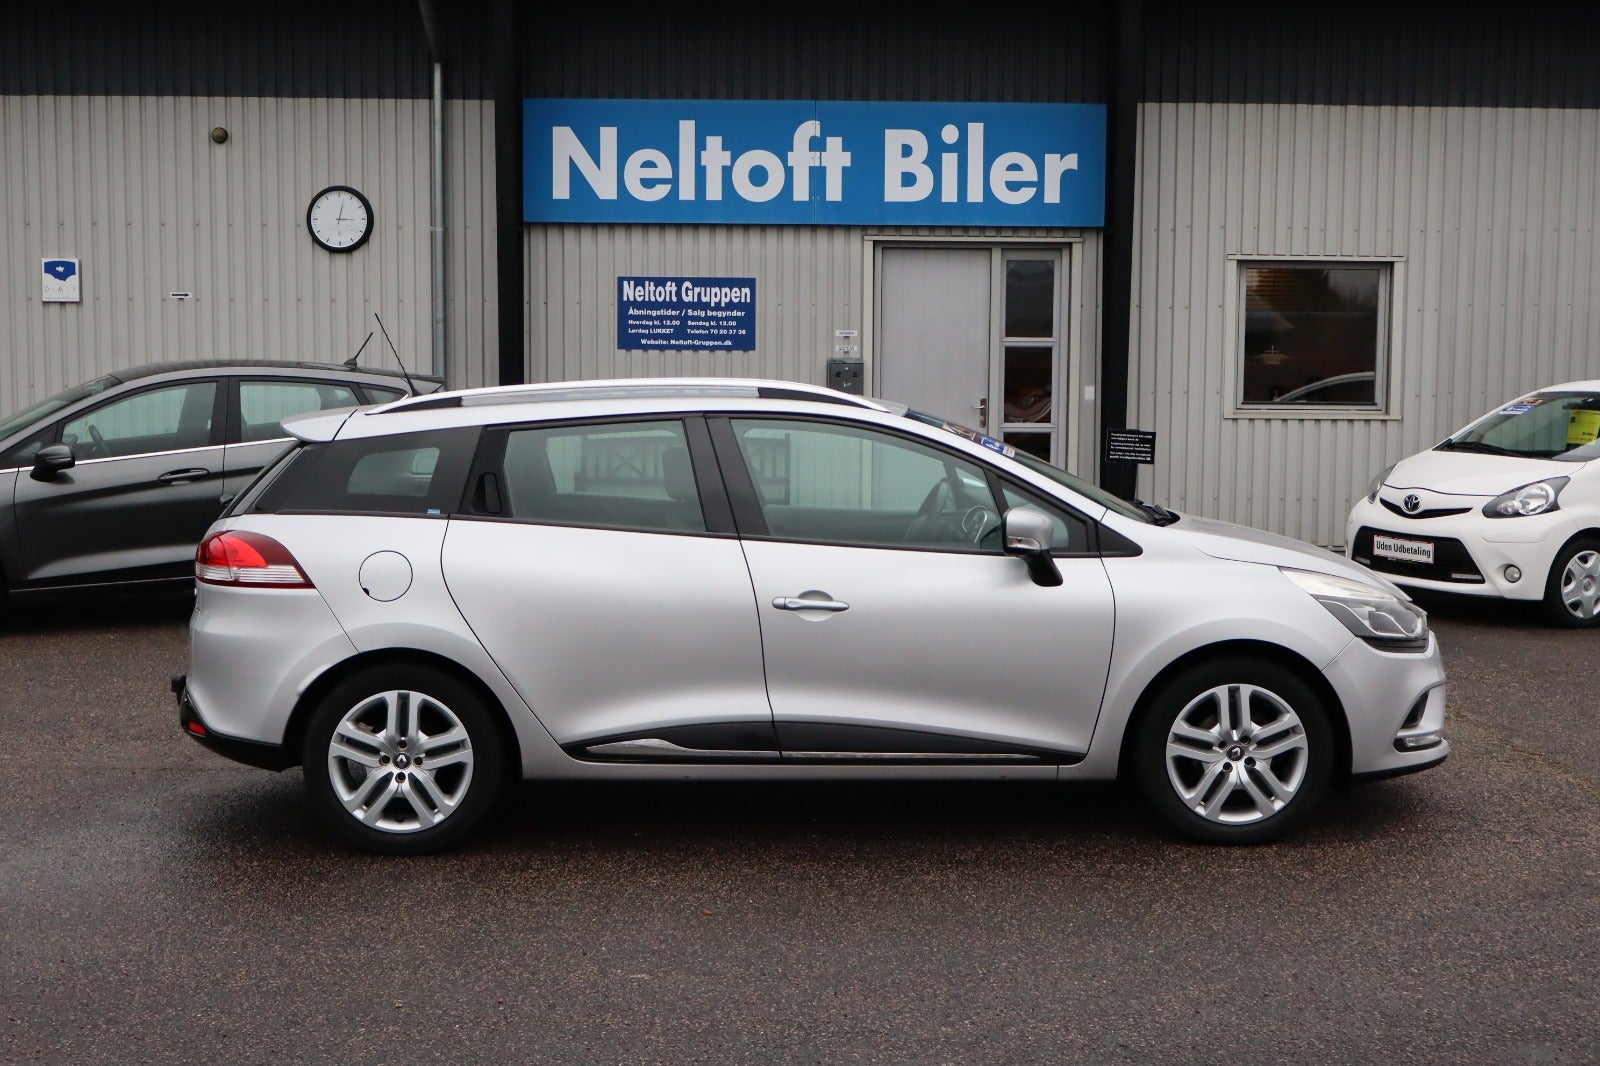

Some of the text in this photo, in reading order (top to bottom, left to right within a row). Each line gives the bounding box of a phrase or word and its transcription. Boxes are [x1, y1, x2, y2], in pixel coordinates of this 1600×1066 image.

[552, 119, 1079, 205] Neltoft Biler
[623, 281, 751, 307] Neltoft Gruppen
[628, 307, 680, 317] Åbningstider
[687, 309, 705, 318] Salg
[707, 309, 745, 318] begynder
[670, 339, 733, 347] Neltoft-Gruppen.dk
[1376, 540, 1431, 558] Uden Udbetaling
